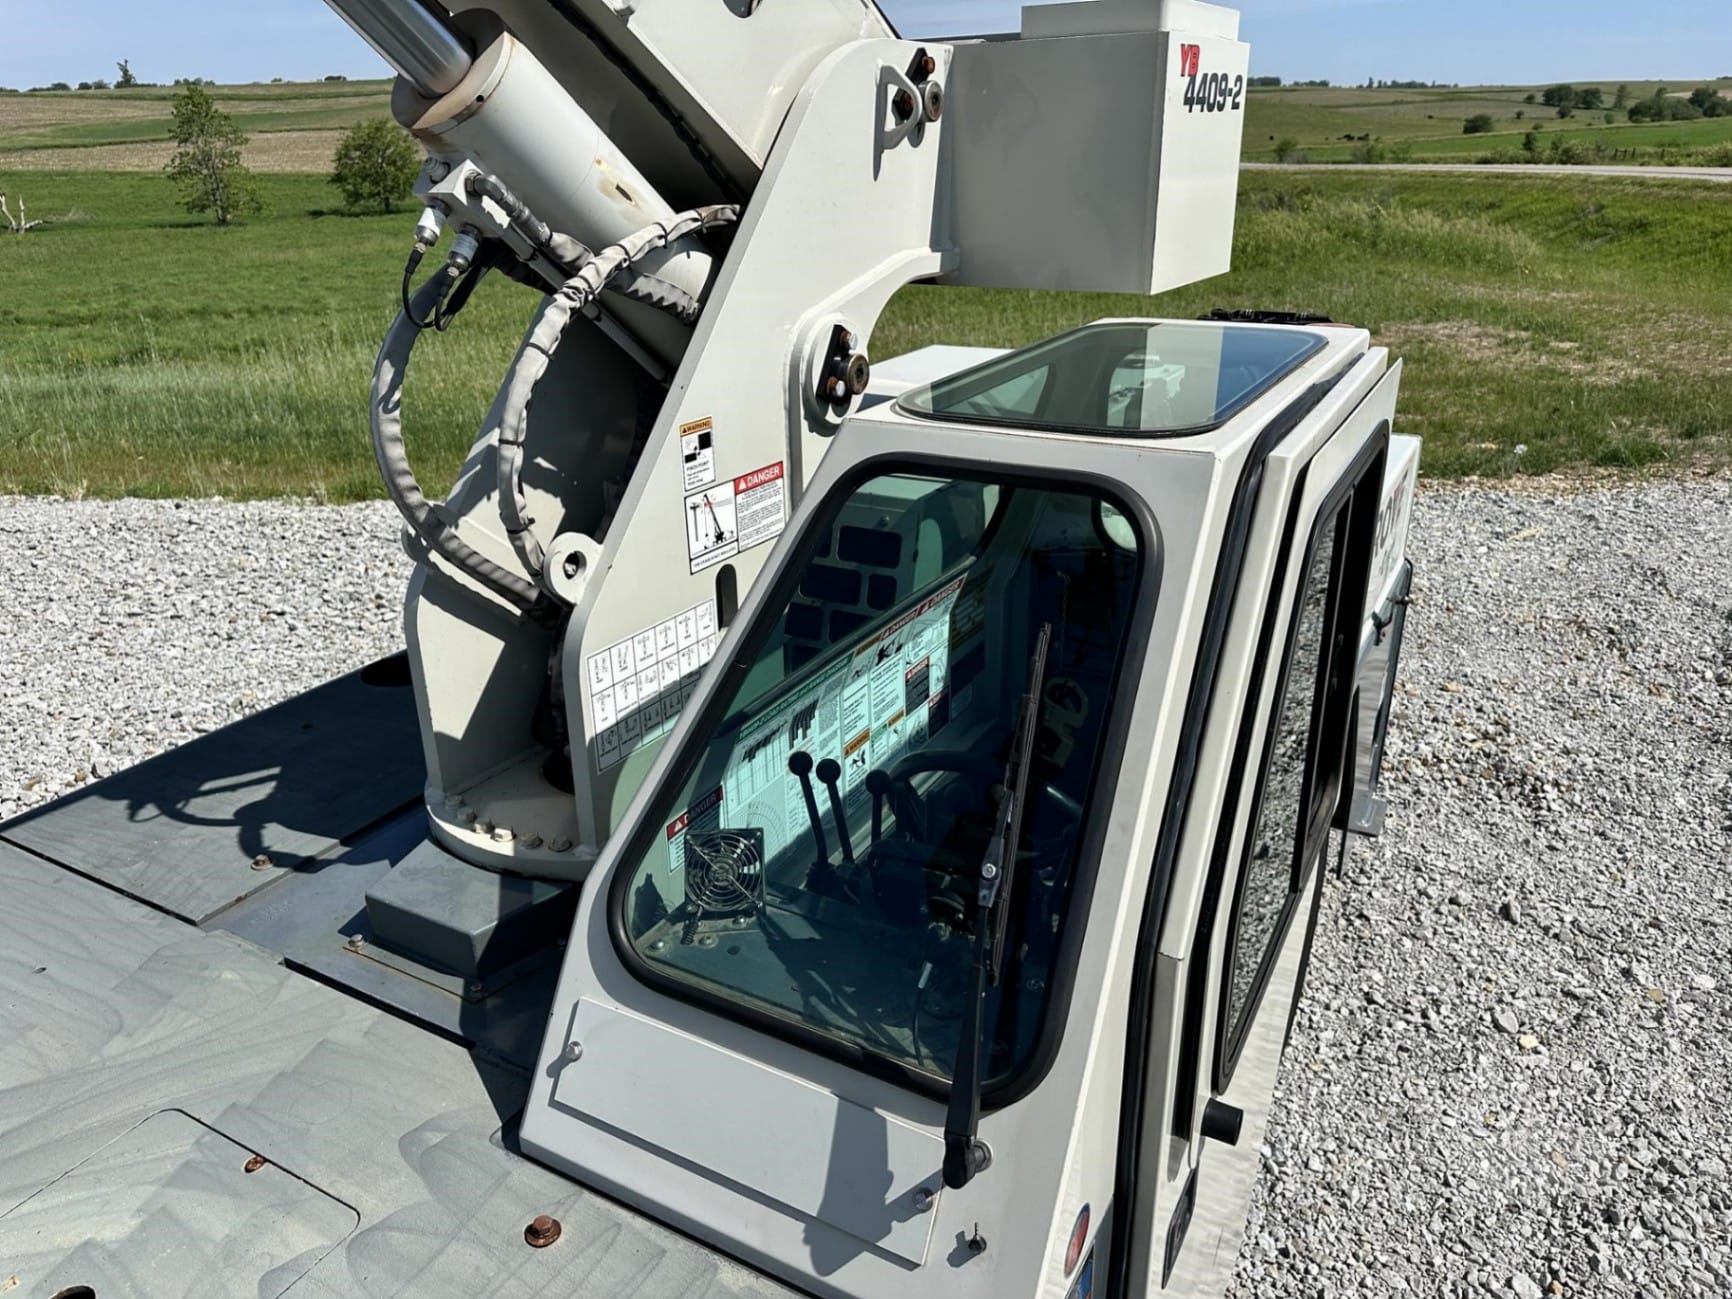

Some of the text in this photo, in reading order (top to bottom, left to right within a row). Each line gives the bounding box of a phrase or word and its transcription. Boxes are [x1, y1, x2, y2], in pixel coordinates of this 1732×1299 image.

[1180, 43, 1200, 77] YB
[1183, 73, 1243, 113] 4409-2
[747, 466, 780, 485] DANGER
